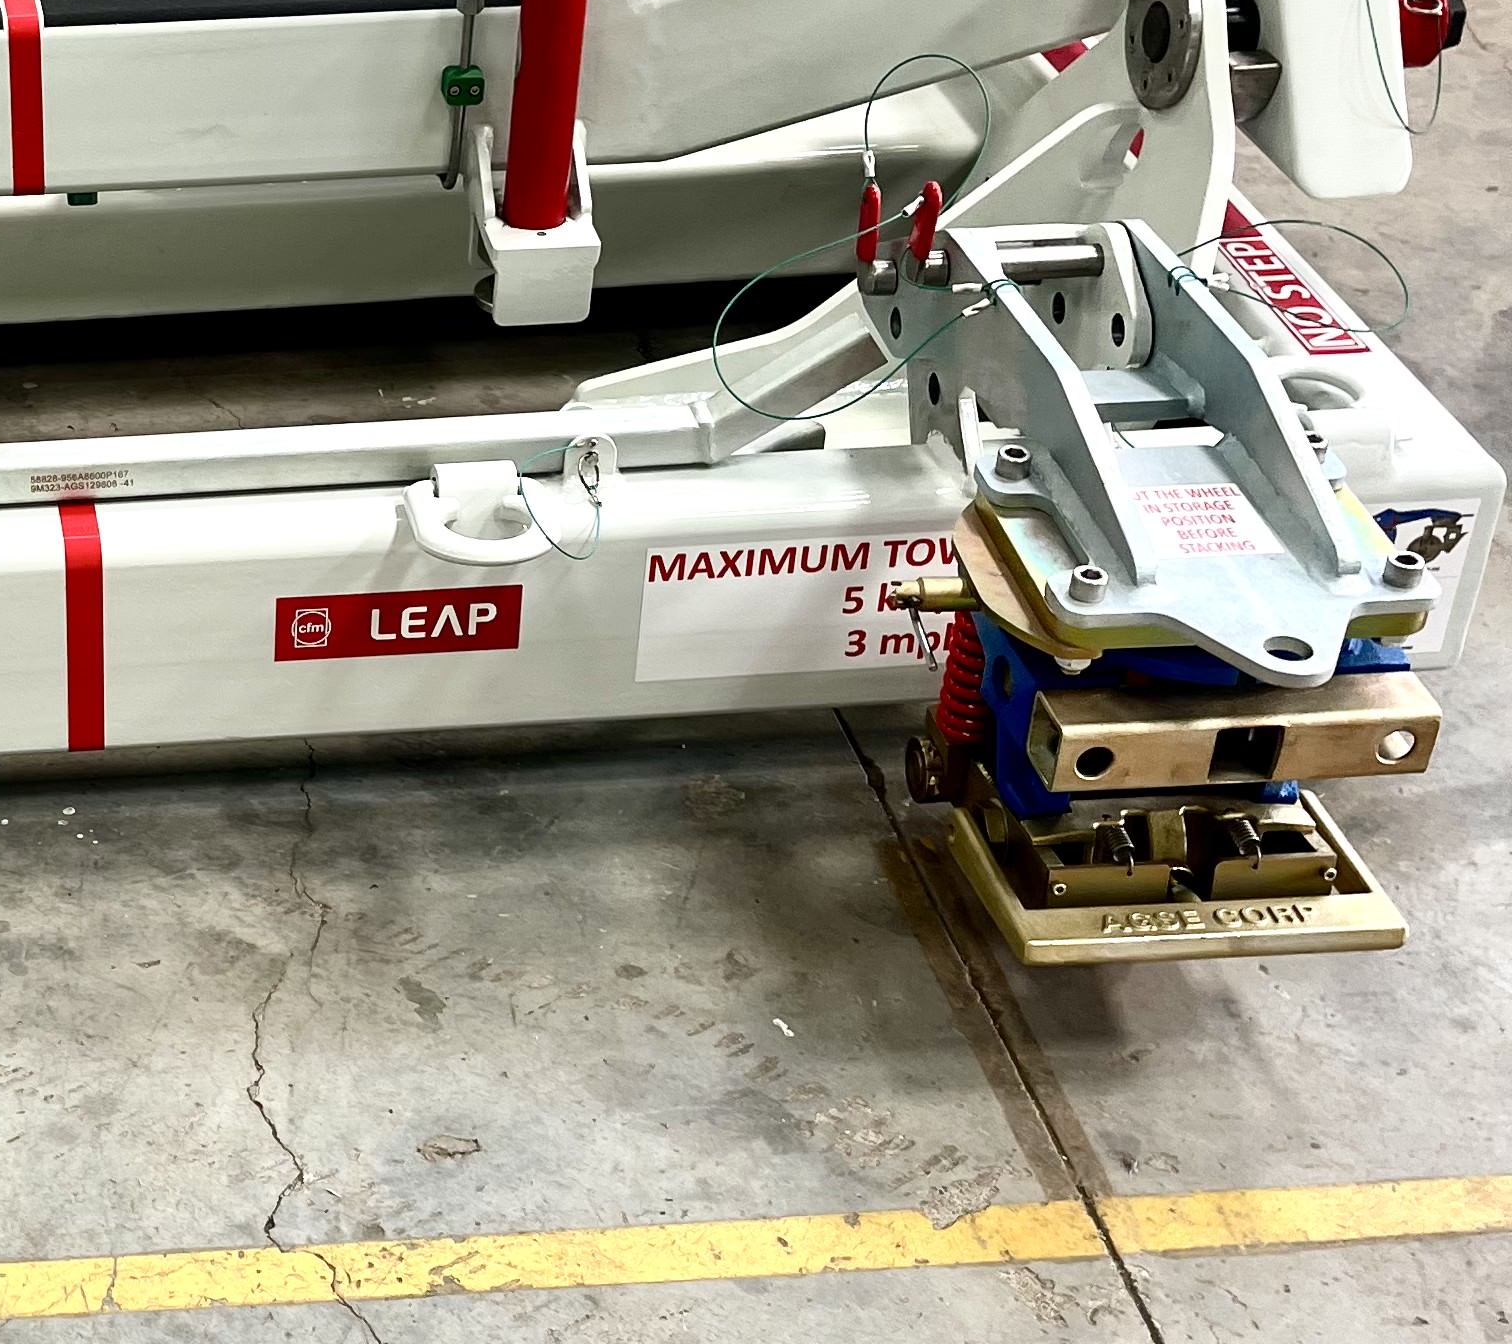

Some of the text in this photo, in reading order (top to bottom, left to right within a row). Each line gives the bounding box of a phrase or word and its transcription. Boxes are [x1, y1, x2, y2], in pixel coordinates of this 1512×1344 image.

[1226, 242, 1358, 347] NO STEP
[1154, 489, 1183, 500] THE
[1184, 486, 1241, 498] WHEEL
[1143, 500, 1236, 514] IN STORAGE
[1160, 514, 1236, 527] POSITION
[1177, 527, 1238, 540] BEFORE
[1179, 540, 1257, 554] STACKING
[648, 542, 870, 582] MAXIMUM
[842, 586, 864, 614] 5
[298, 623, 325, 634] cfm
[370, 602, 498, 641] LEAP
[844, 630, 866, 657] 3
[1212, 903, 1314, 929] CORP
